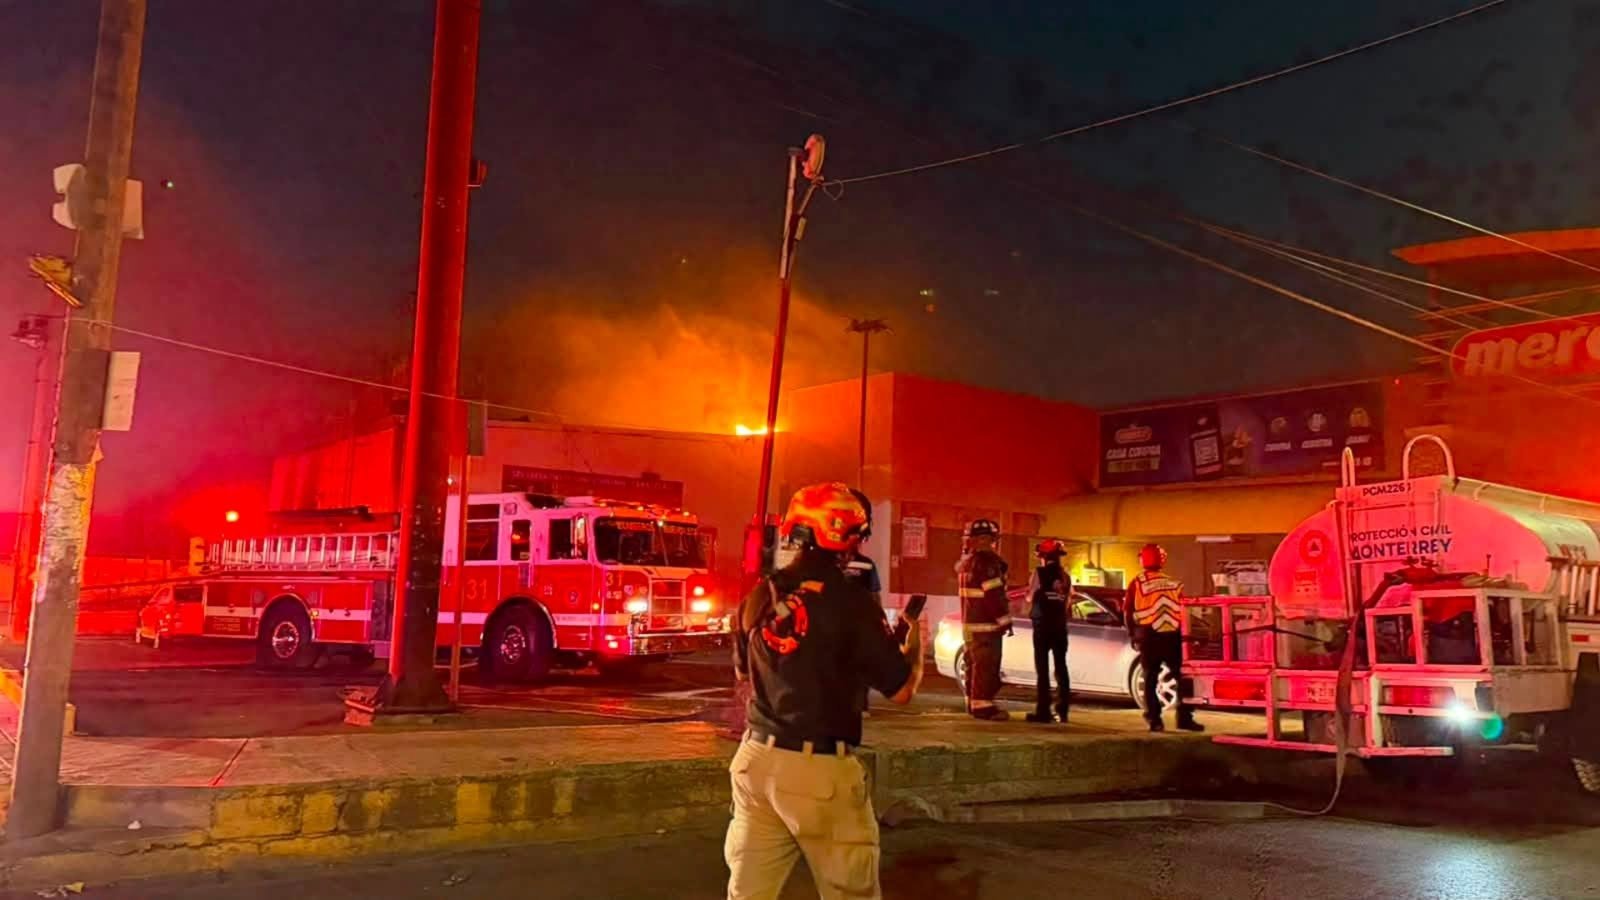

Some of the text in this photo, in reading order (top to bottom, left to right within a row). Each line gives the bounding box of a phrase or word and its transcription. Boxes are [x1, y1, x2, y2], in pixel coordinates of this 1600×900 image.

[1349, 524, 1417, 543] ROTECCIÓN
[465, 578, 488, 600] 31
[605, 572, 622, 587] 31
